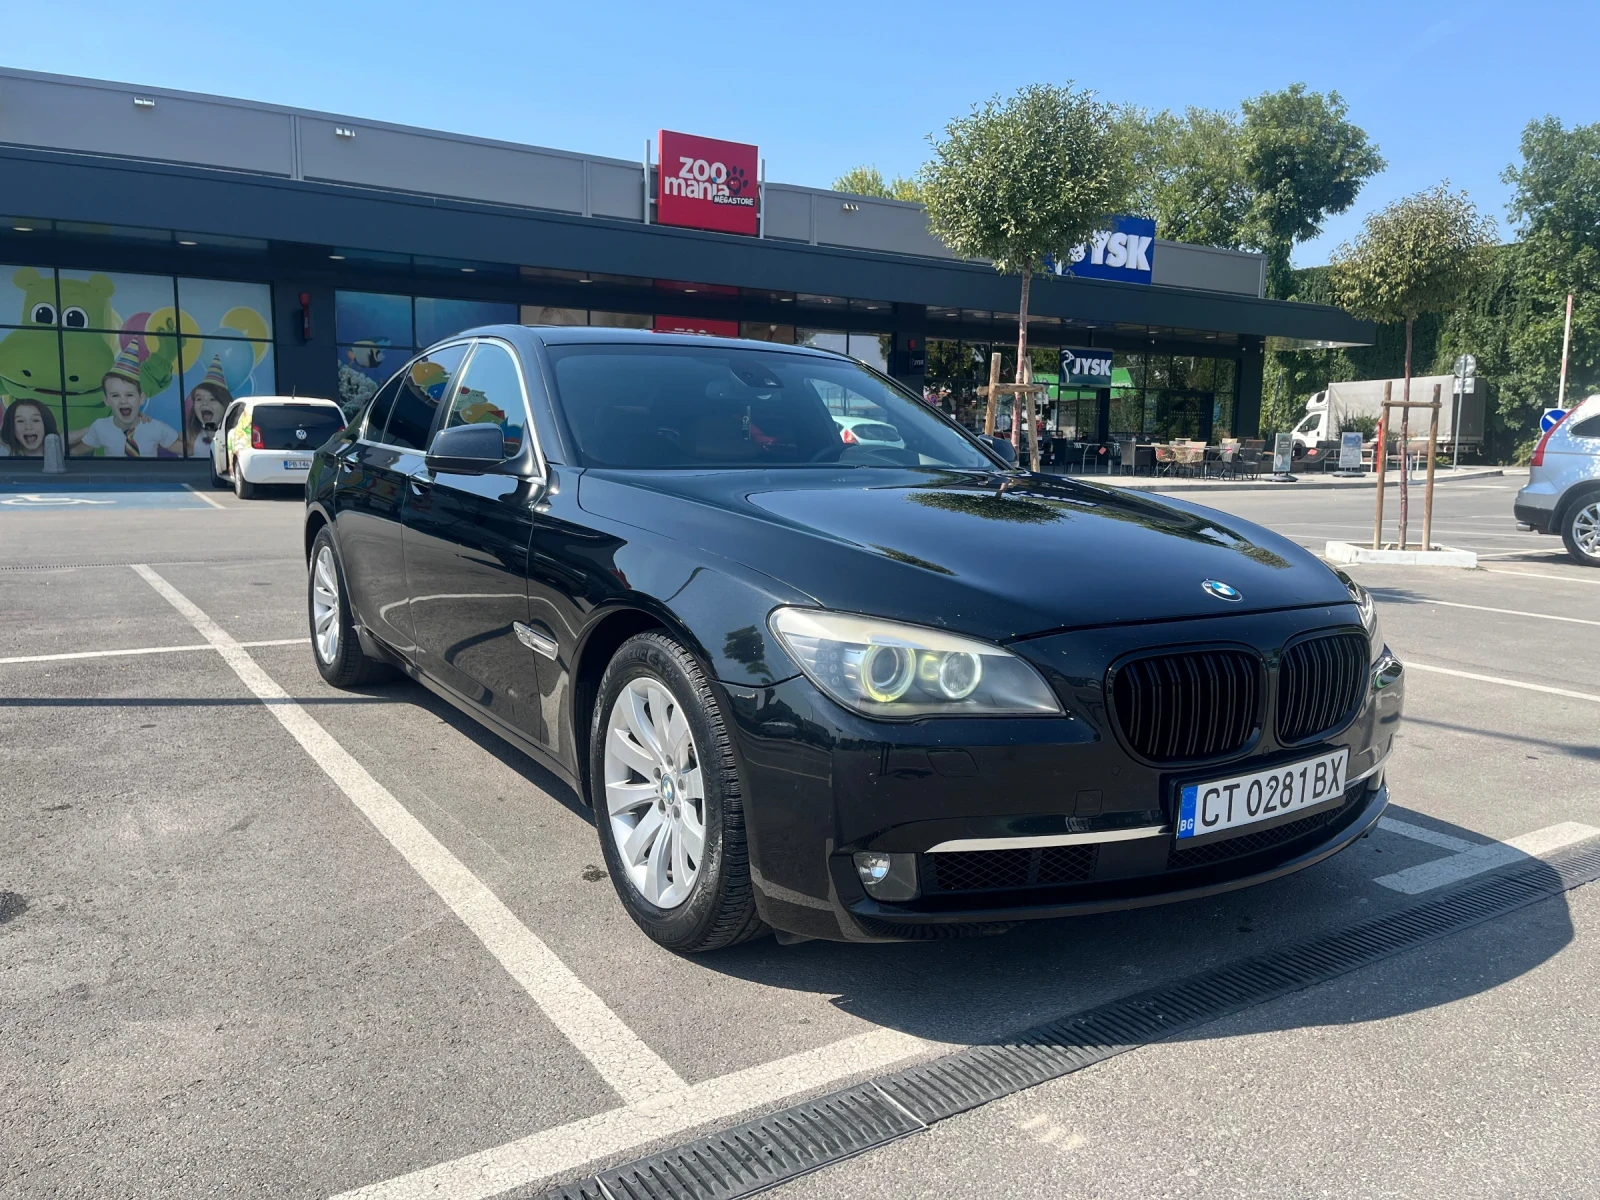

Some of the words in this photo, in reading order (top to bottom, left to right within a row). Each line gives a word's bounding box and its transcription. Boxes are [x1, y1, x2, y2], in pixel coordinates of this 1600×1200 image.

[664, 176, 730, 201] mania
[713, 195, 754, 206] MEGASTORE
[1072, 357, 1112, 377] JYSK
[1201, 783, 1241, 828] CT
[1246, 766, 1308, 818] 0281
[1312, 755, 1344, 799] BX
[1180, 818, 1194, 832] BG
